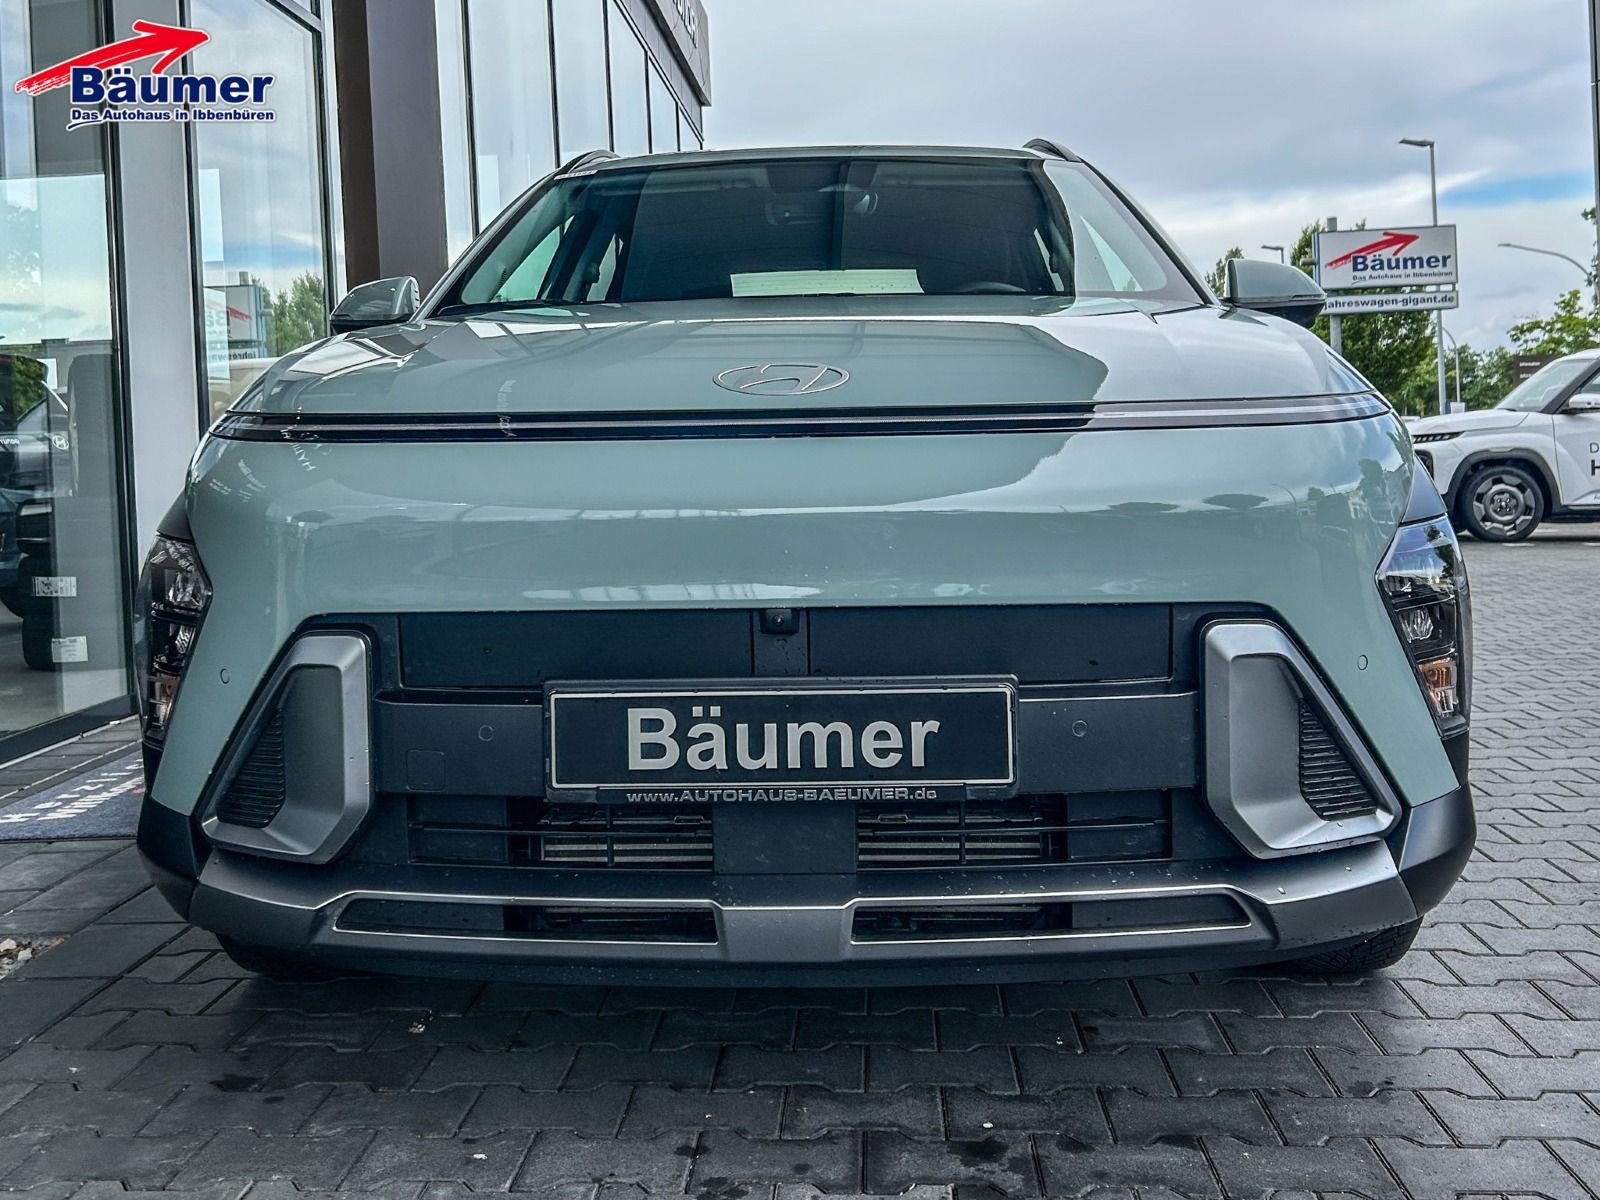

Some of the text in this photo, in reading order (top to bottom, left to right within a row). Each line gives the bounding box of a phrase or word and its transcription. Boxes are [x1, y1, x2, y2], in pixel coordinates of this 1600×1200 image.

[1352, 254, 1452, 272] Bäumer
[627, 705, 941, 772] Bäumer
[626, 787, 938, 803] www.AUTOHAUS-BAEUMER.de
